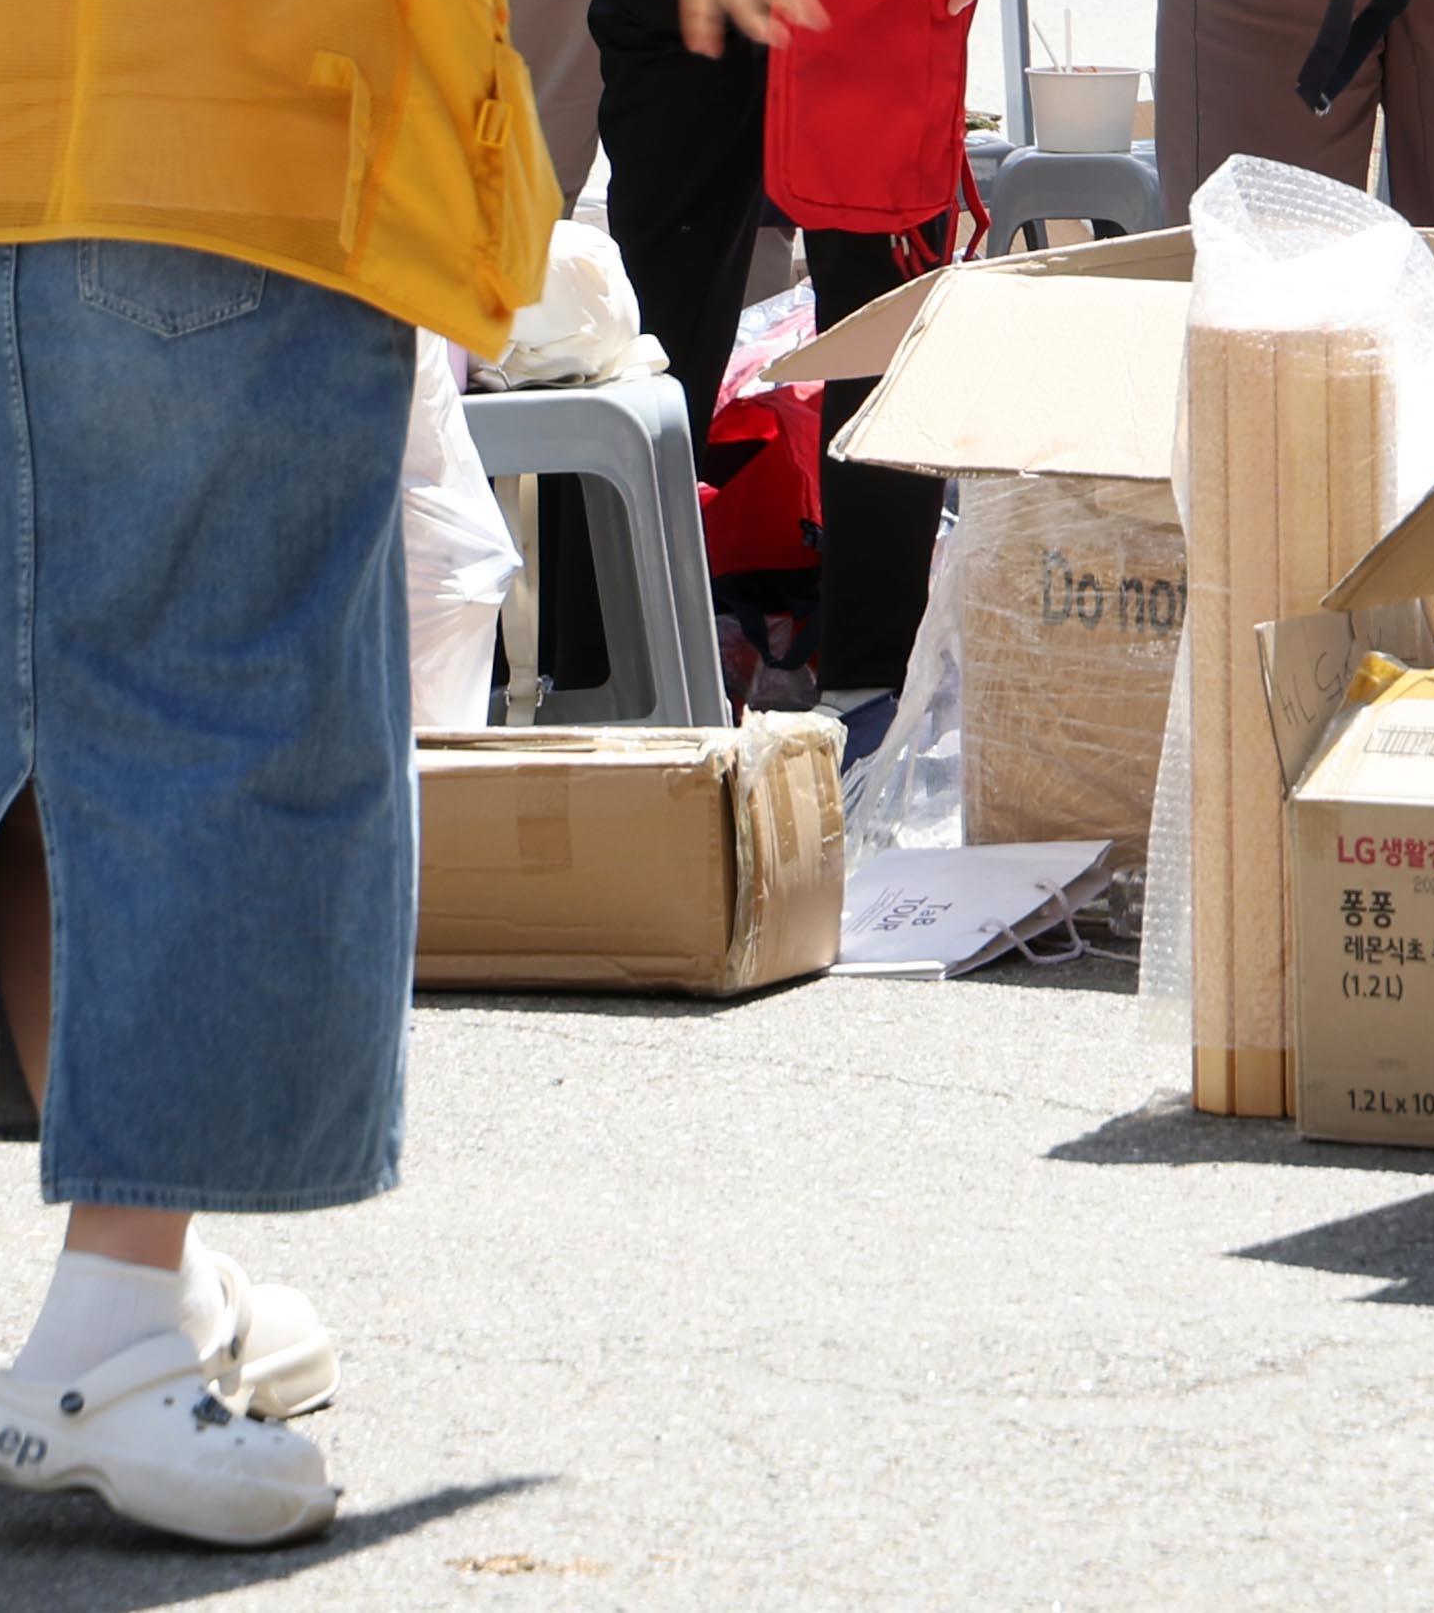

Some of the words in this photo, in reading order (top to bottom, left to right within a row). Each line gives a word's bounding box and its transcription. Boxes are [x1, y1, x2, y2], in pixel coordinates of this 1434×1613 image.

[1040, 551, 1104, 629] Do
[1337, 835, 1376, 865] LG
[872, 895, 929, 931] TOUR
[1343, 935, 1426, 966] 레몬식초
